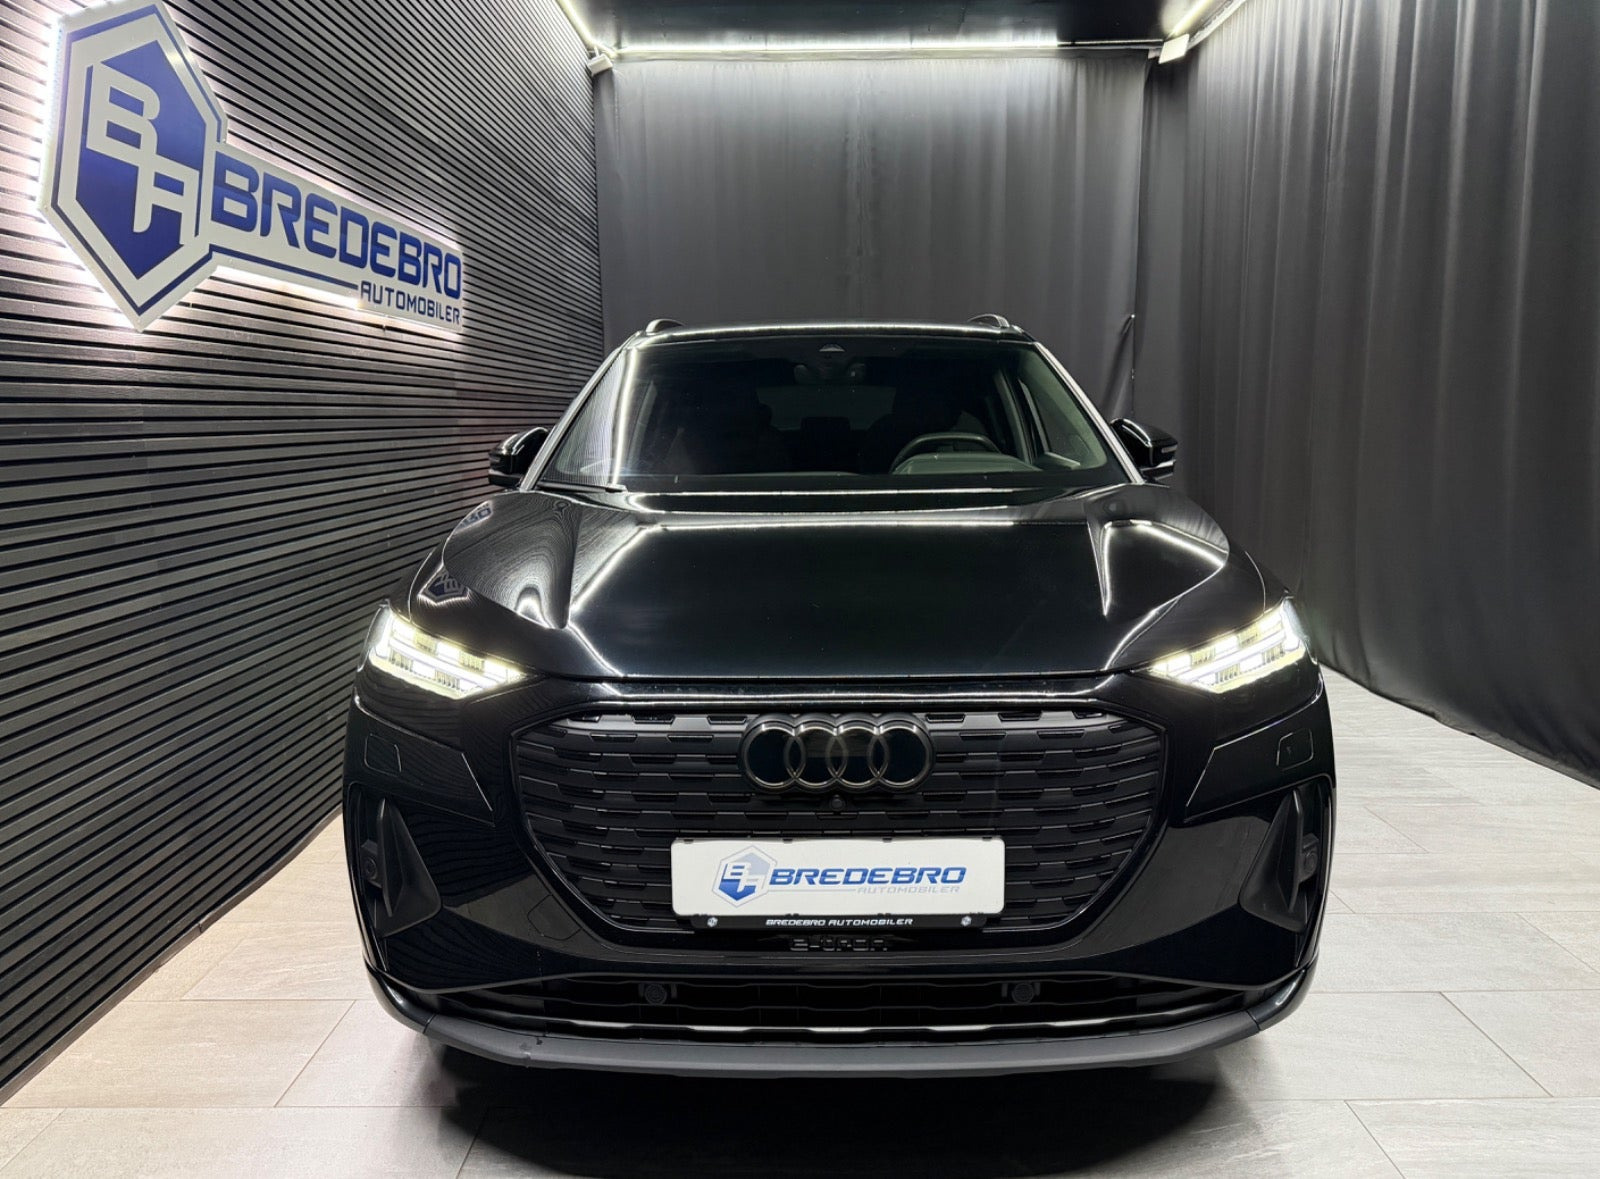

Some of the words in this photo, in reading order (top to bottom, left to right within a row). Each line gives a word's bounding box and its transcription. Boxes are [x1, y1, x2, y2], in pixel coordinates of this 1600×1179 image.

[210, 151, 462, 300] BREDEBRO
[360, 280, 460, 325] AUTOMOBILER
[769, 866, 967, 886] BREDEBRO
[857, 886, 960, 894] AUTOMOBILER
[765, 918, 826, 927] BREDEBRO
[828, 917, 914, 927] AUTOMOBILER
